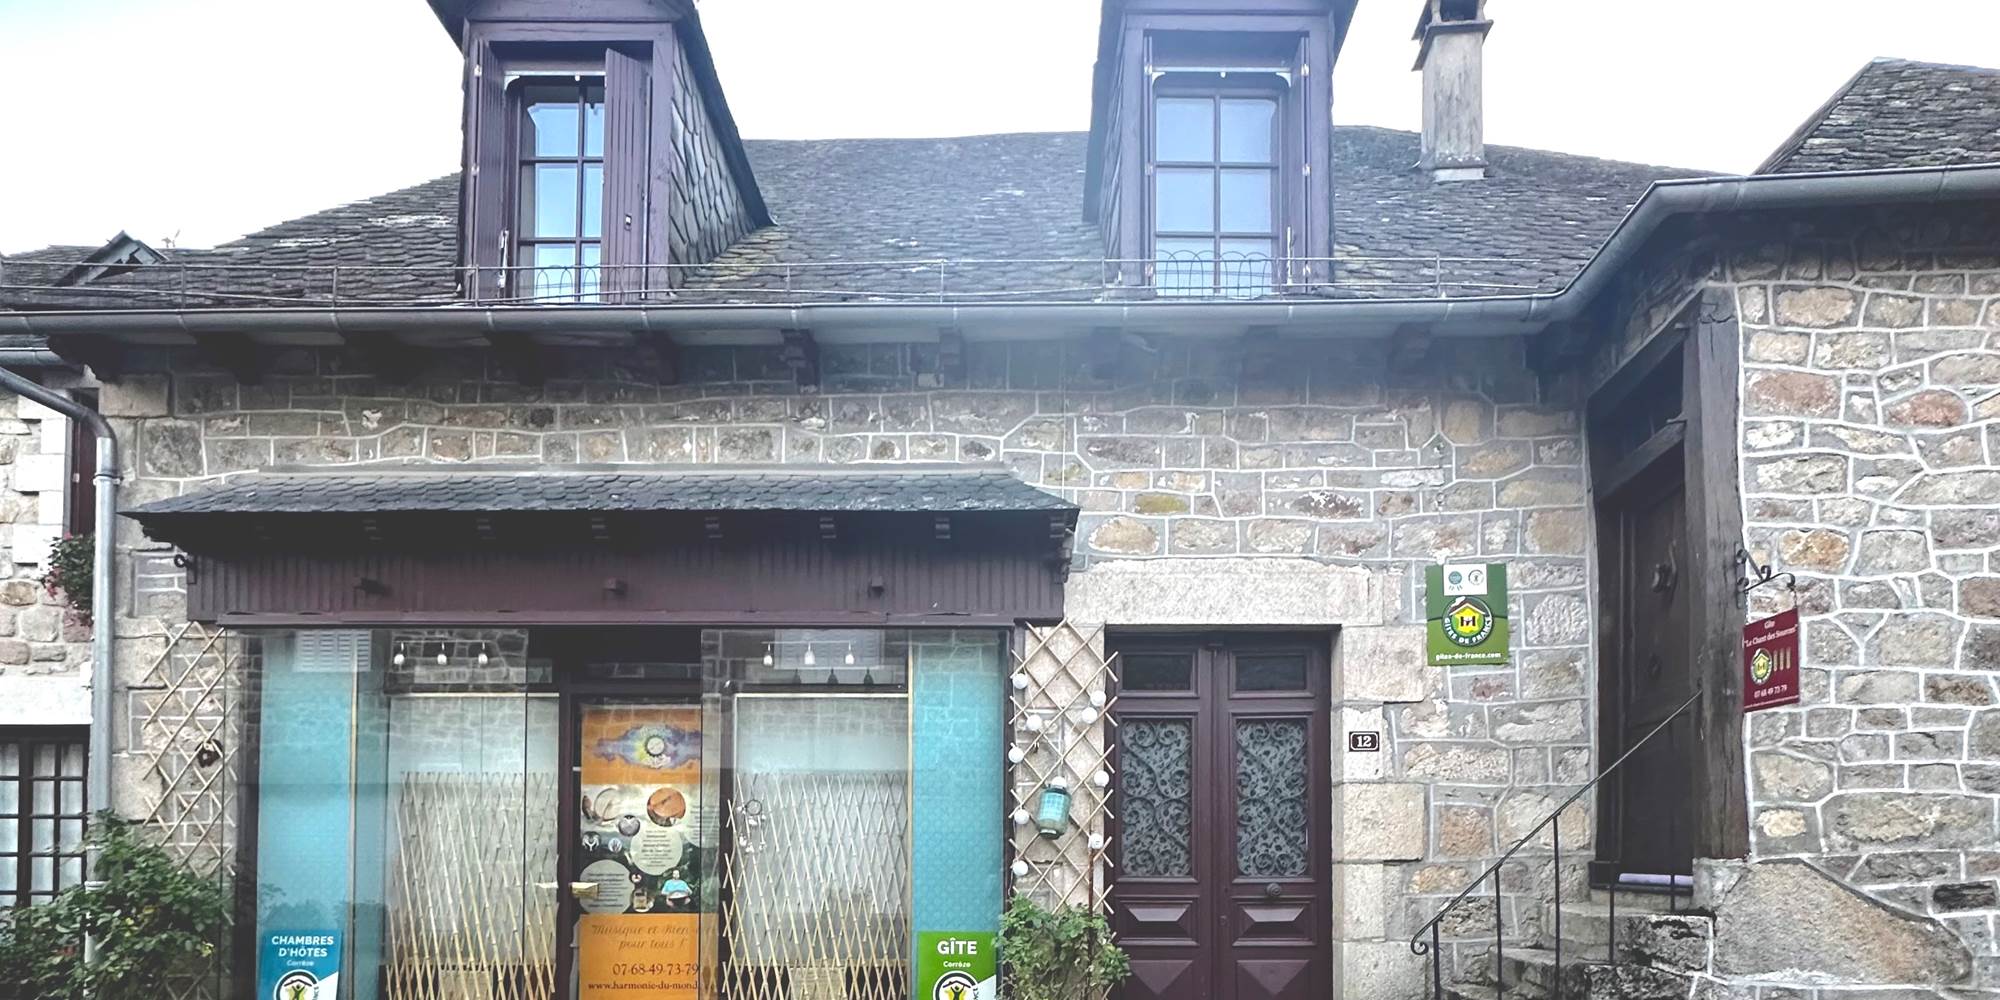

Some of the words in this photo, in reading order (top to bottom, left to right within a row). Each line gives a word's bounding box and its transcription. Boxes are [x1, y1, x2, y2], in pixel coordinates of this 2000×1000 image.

[1357, 735, 1372, 747] 12
[647, 925, 657, 934] et
[272, 936, 334, 945] CHAMBRES
[618, 939, 646, 951] pour
[937, 937, 978, 955] GÎTE
[278, 945, 328, 957] D'HÔTES
